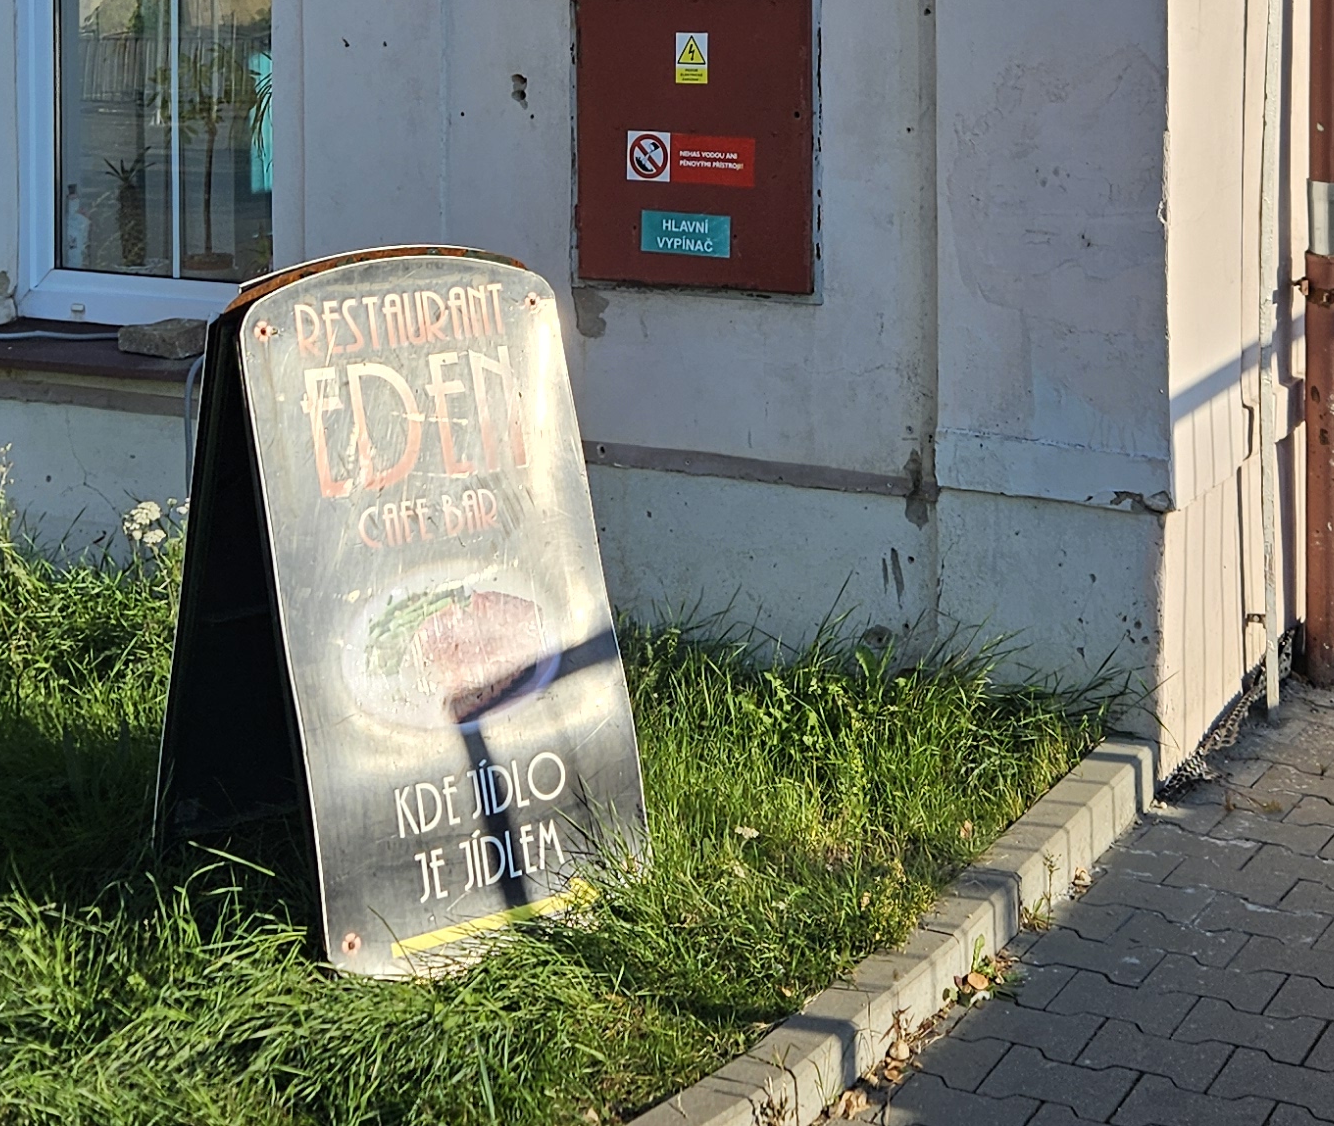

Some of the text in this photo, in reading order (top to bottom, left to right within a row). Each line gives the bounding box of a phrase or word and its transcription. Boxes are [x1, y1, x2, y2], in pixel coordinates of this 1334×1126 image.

[656, 235, 713, 253] VYPÍNAČ
[662, 218, 708, 234] HLAVNÍ
[294, 282, 504, 358] RESTAURANT
[300, 345, 530, 499] EDEN
[358, 488, 501, 549] CAFE BAR
[394, 751, 566, 839] KDE JÍDLO
[414, 818, 566, 904] JE JÍDLEM
